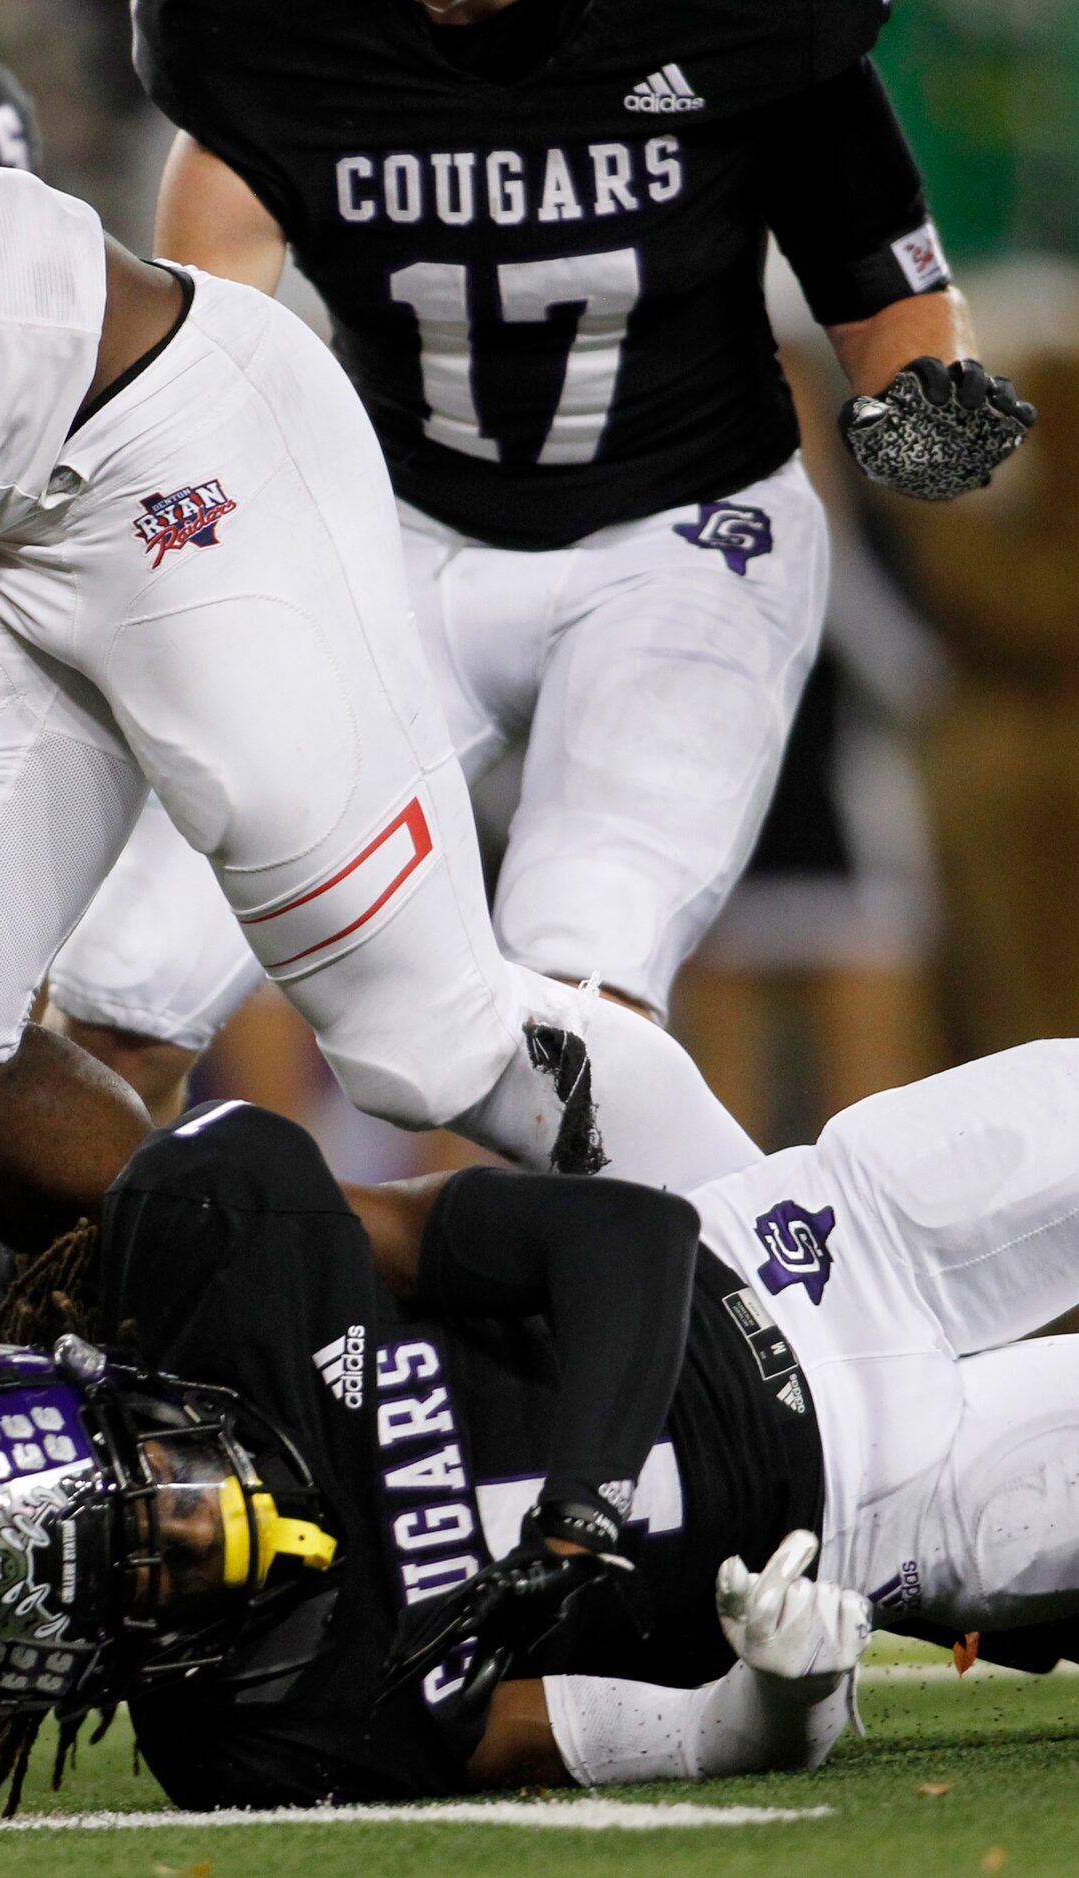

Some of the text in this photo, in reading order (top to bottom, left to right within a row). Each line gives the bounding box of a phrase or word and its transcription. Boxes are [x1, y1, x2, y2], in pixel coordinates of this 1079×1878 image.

[623, 93, 705, 113] adidas
[335, 133, 684, 226] COUGARS
[390, 246, 641, 465] 17
[135, 481, 227, 541] RYAN
[152, 488, 192, 512] DENTON
[344, 1324, 366, 1410] adidas
[770, 1340, 787, 1356] M
[788, 1373, 806, 1414] adidas
[376, 1340, 481, 1704] CUGARS
[61, 1519, 76, 1604] COLLEGE STATION
